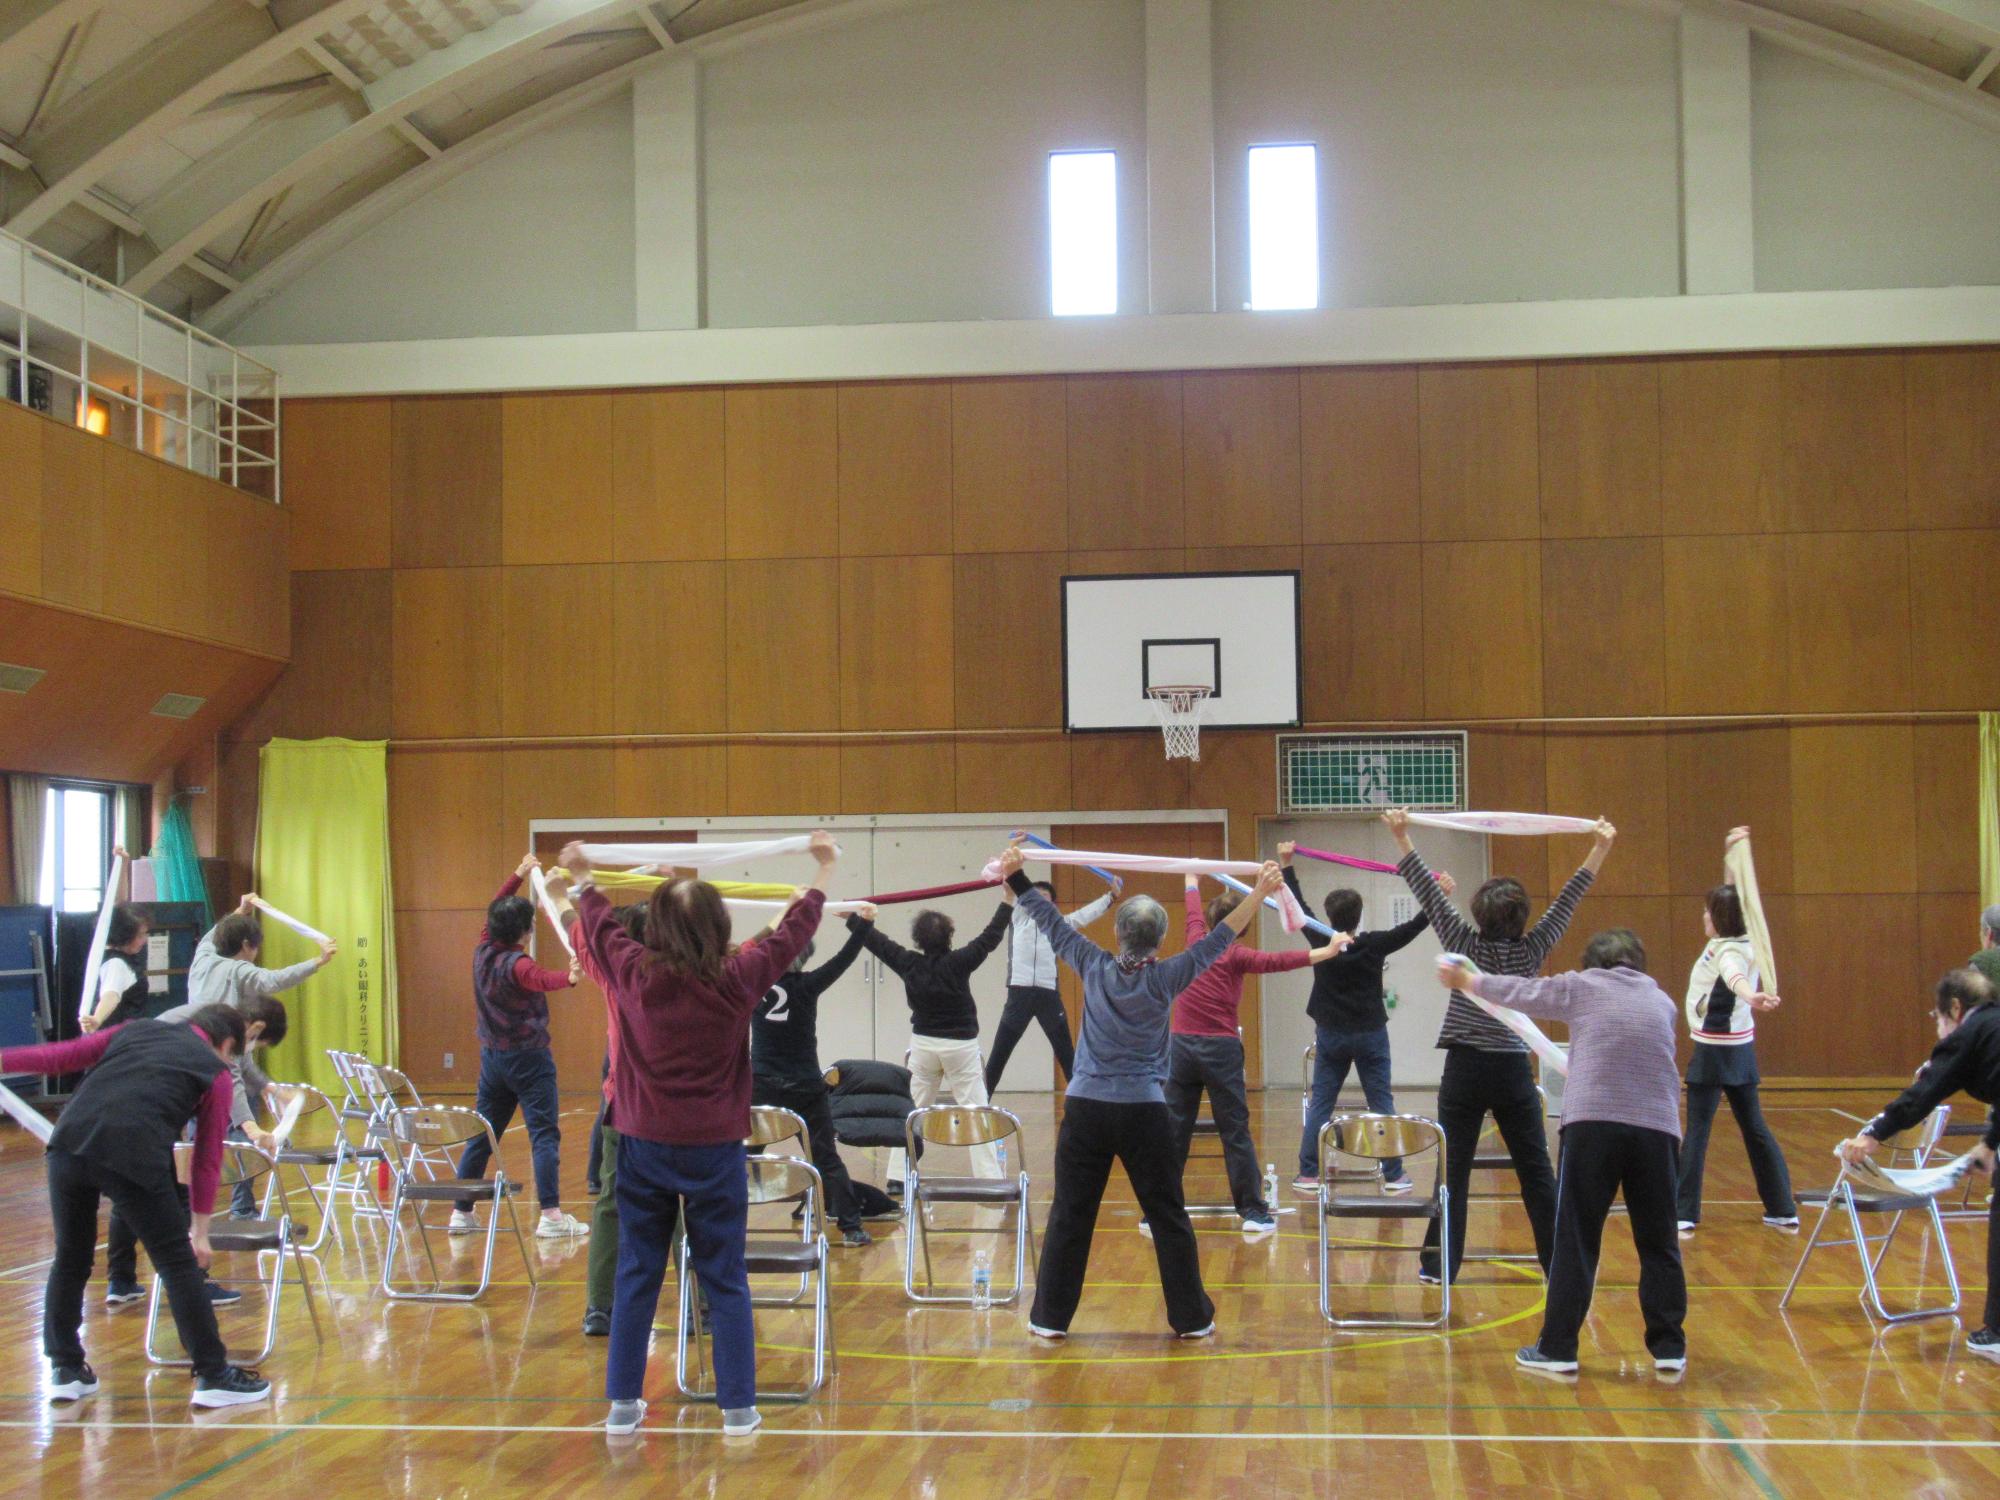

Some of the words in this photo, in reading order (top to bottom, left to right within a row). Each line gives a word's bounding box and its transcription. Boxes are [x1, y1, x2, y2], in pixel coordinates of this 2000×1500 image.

[358, 958, 369, 1057] あい眼科クリニック
[762, 984, 790, 1021] 2
